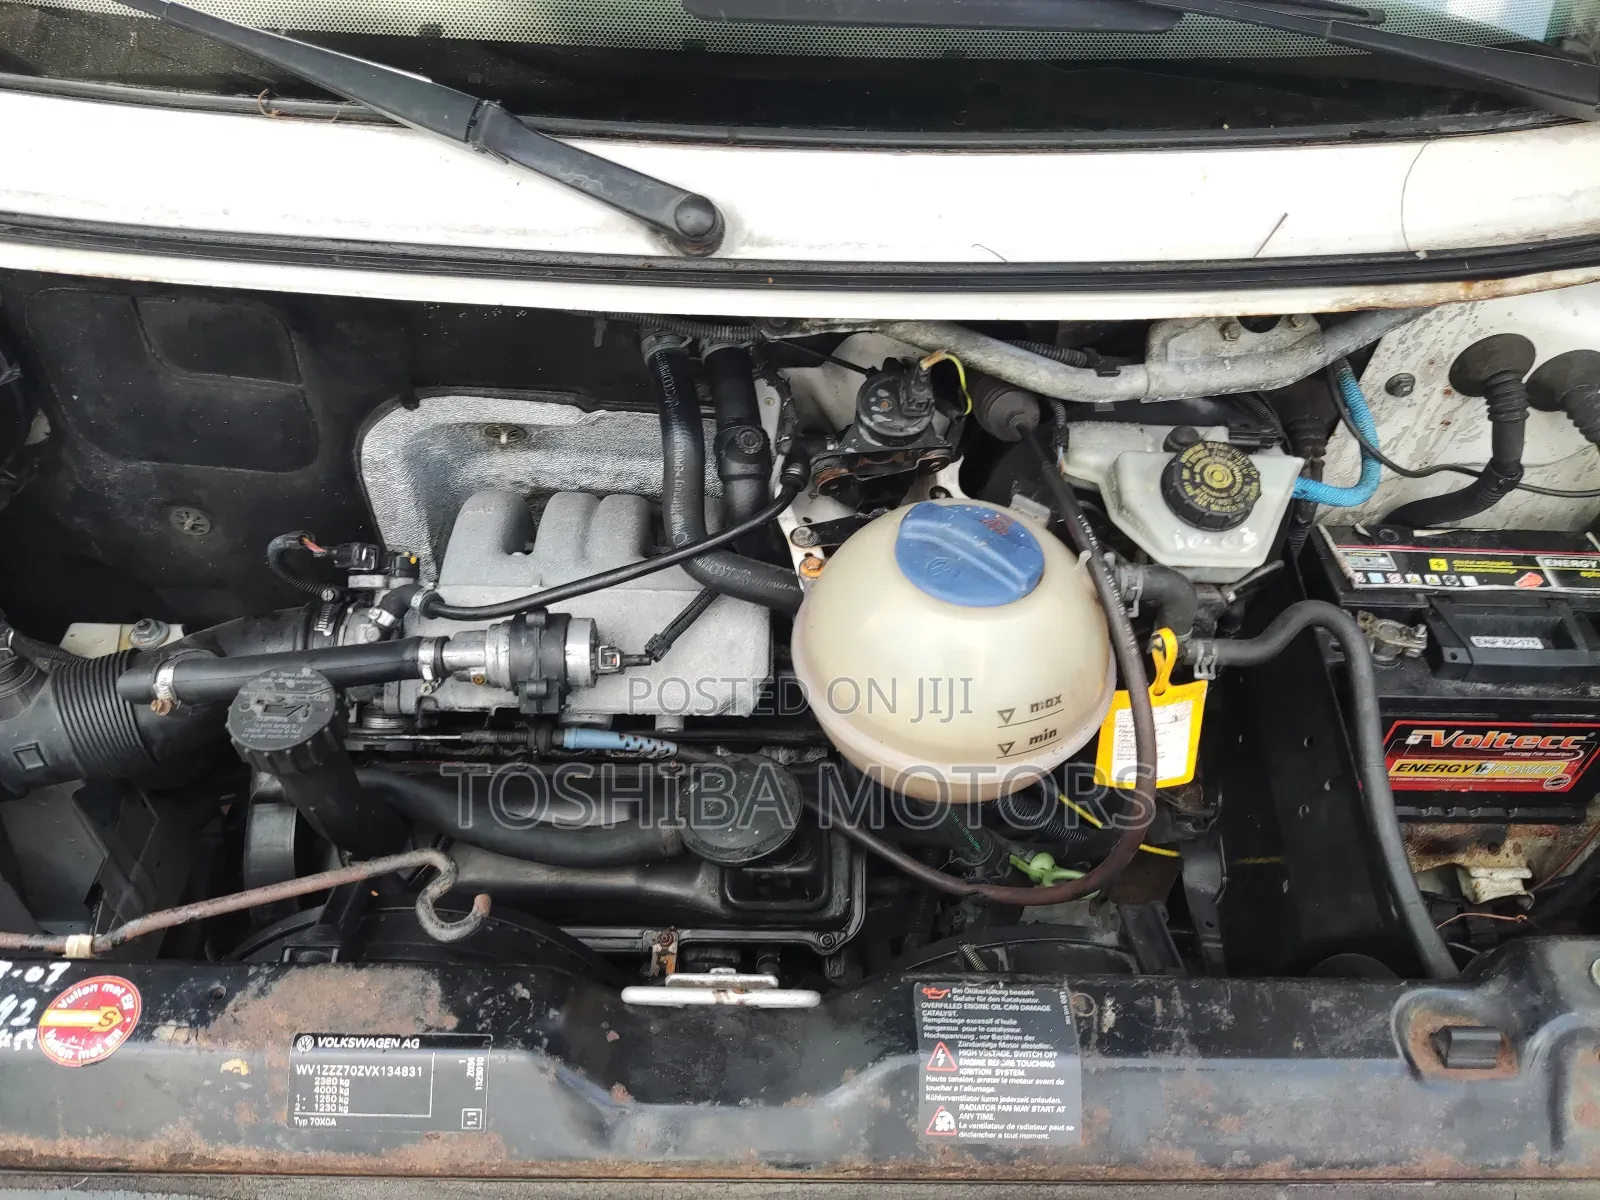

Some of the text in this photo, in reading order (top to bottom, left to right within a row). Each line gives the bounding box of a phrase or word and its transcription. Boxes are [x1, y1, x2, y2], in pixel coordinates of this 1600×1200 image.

[1544, 558, 1598, 568] ENERGY
[1029, 693, 1063, 714] max
[1028, 728, 1057, 746] min
[1407, 729, 1588, 750] Voltecc
[1394, 763, 1476, 774] ENERGY
[1492, 763, 1562, 775] POWER
[921, 1002, 963, 1010] OVERFILLED
[1020, 1004, 1052, 1012] DAMAGE
[317, 1036, 420, 1049] VOLKSWAGEN AG
[958, 1049, 978, 1057] HIGH
[1013, 1050, 1043, 1059] SWITCH
[1043, 1051, 1059, 1059] OFF
[958, 1058, 986, 1067] ENGINE
[1016, 1059, 1056, 1069] TOUCHING
[959, 1068, 992, 1076] IGNITION
[314, 1077, 350, 1088] 2380 kg
[925, 1074, 947, 1083] Haute
[314, 1086, 350, 1096] 4000 kg
[925, 1084, 953, 1092] toucher
[338, 1094, 350, 1105] kg
[314, 1103, 337, 1112] 1230
[338, 1103, 349, 1114] kg
[958, 1104, 1067, 1114] RADIATOR FAN MAY START AT
[958, 1112, 996, 1121] ANY TIME.
[293, 1117, 337, 1127] Typ 70X0A
